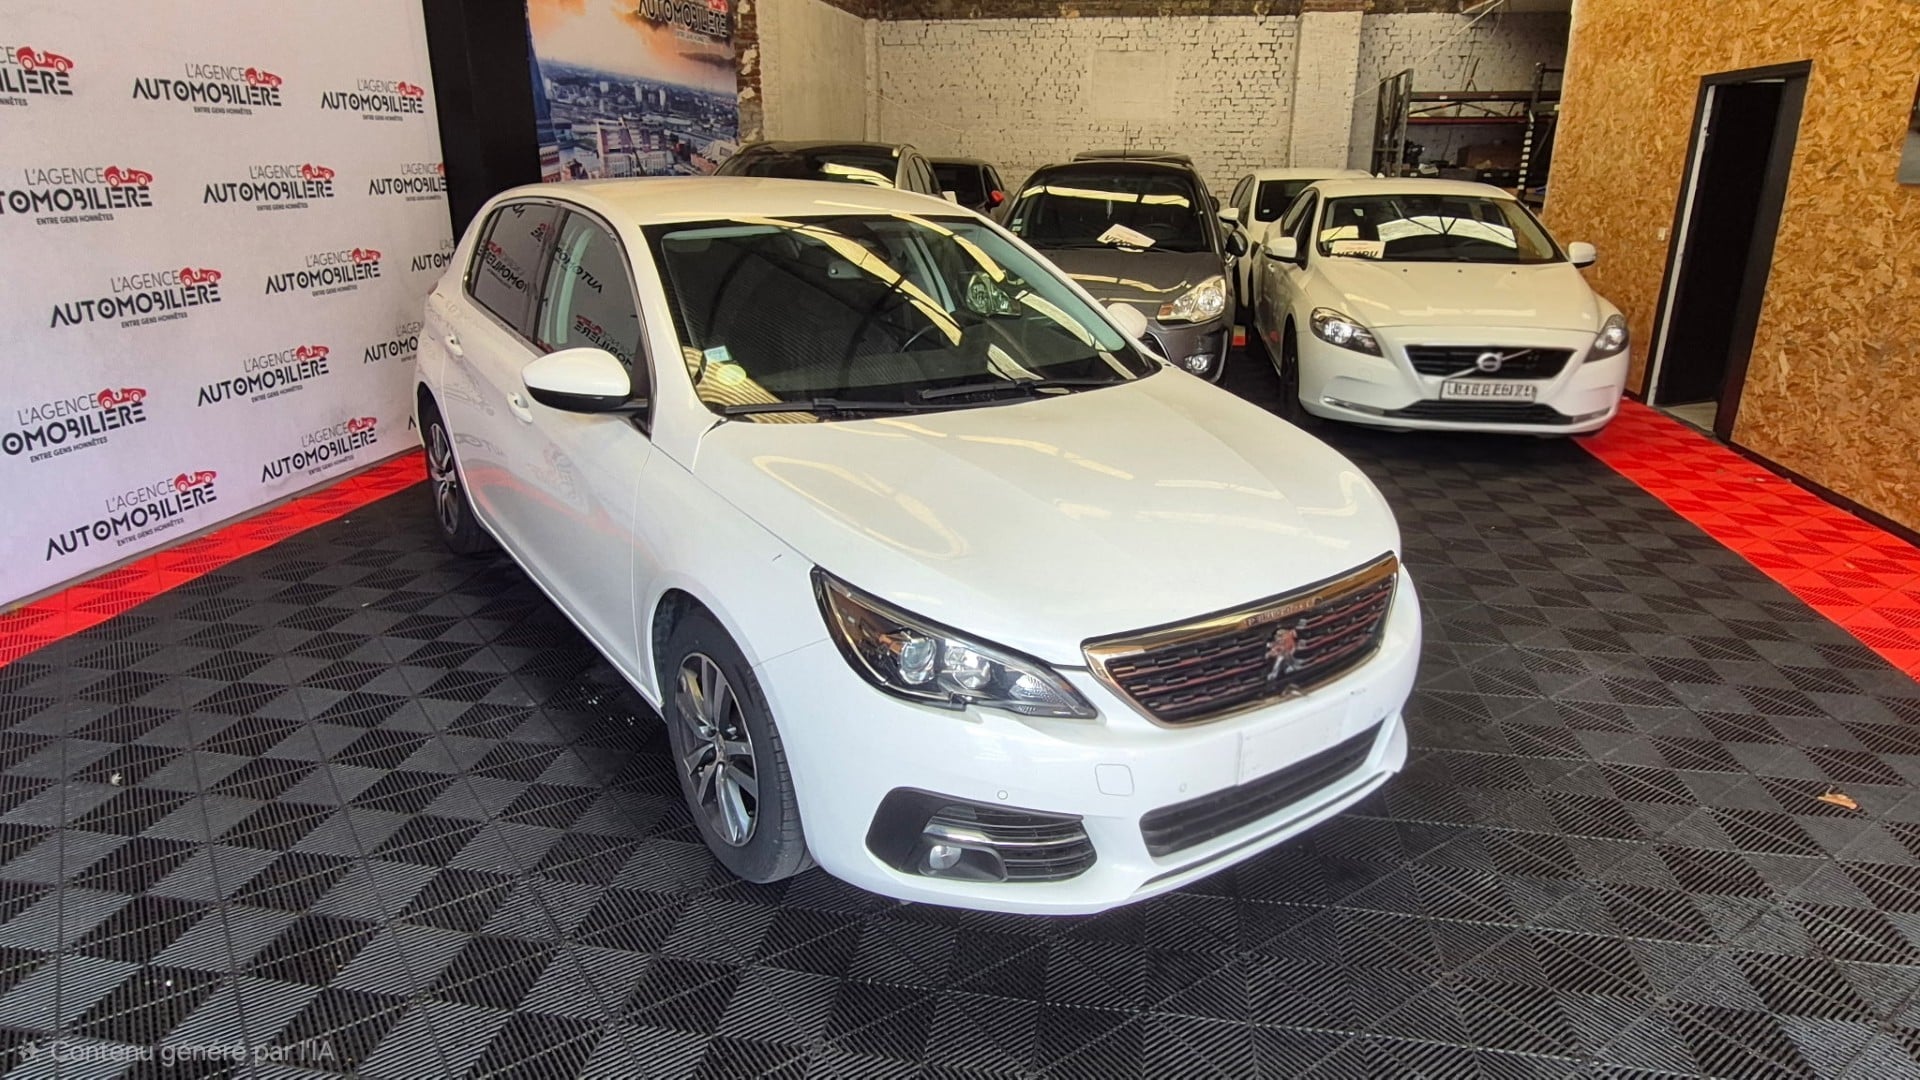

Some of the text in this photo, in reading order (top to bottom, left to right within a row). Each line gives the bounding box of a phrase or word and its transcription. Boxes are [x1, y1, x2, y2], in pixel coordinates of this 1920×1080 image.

[185, 62, 246, 82] L'AGENCE
[24, 167, 106, 186] L'AGENCE
[249, 165, 303, 180] L'AGENCE
[305, 249, 352, 268] L'AGENCE
[110, 270, 181, 293] L'AGENCE
[242, 348, 297, 373] L'AGENCE
[16, 392, 100, 427] L'AGENCE
[300, 421, 348, 448] L'AGENCE
[105, 478, 176, 513] L'AGENCE
